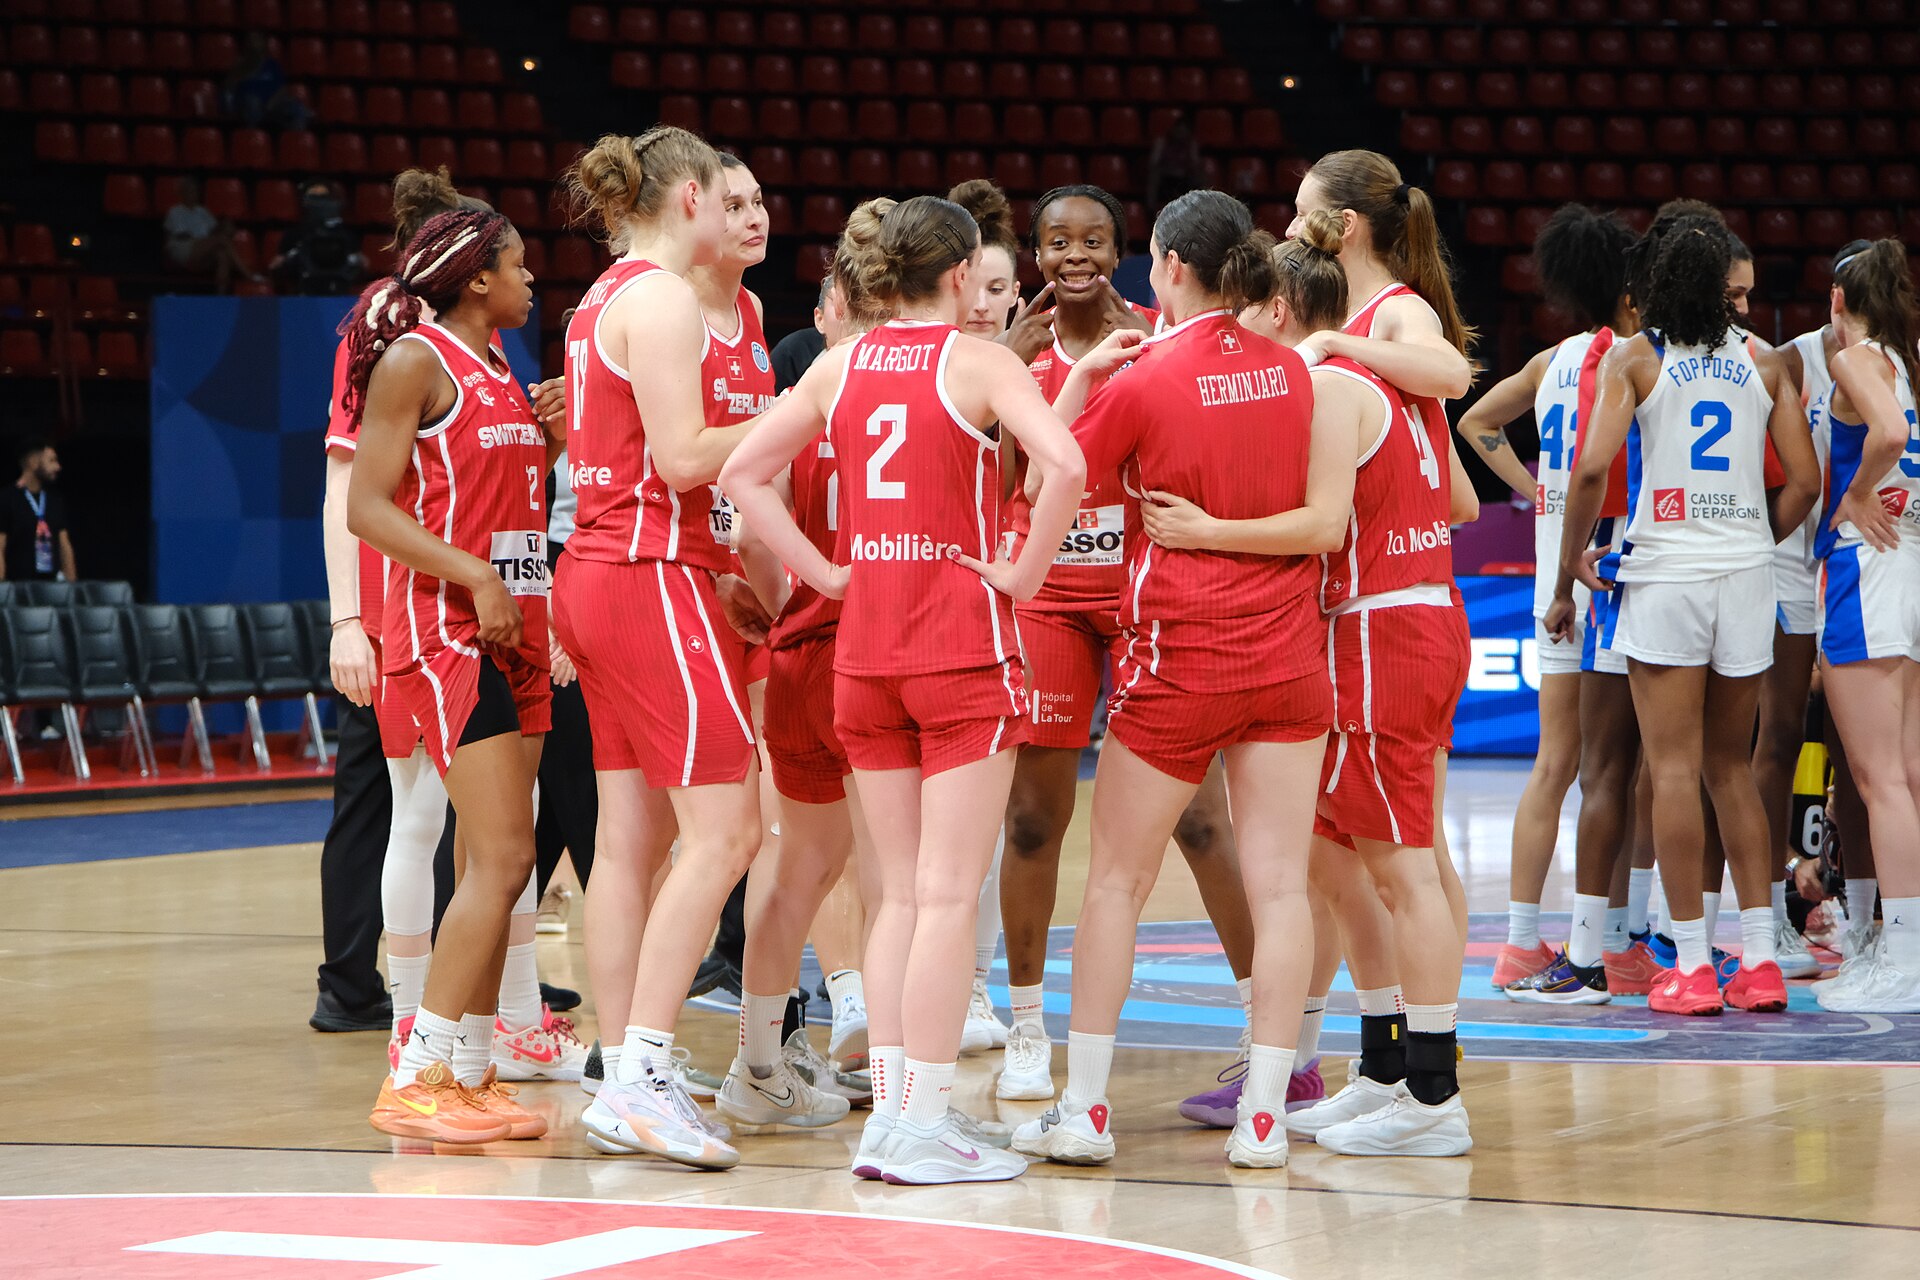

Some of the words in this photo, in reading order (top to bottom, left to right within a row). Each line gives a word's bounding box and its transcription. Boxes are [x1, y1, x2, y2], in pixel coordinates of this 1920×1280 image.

[854, 342, 936, 372] MARGOT
[1558, 367, 1581, 389] LAC
[1667, 357, 1752, 388] FOPPOSSI
[1196, 365, 1289, 407] HERMINJARD
[1690, 400, 1732, 472] 2
[866, 403, 908, 500] 2
[1690, 493, 1737, 506] CAISSE
[1691, 507, 1761, 520] D'EPARGNE
[851, 533, 963, 561] Mobilière
[1386, 529, 1407, 556] la
[491, 557, 547, 582] TISSO
[1095, 555, 1121, 563] SINCE
[1041, 692, 1074, 704] Hôpital
[1041, 703, 1053, 712] de
[1041, 714, 1052, 723] La
[1053, 713, 1073, 723] Tour
